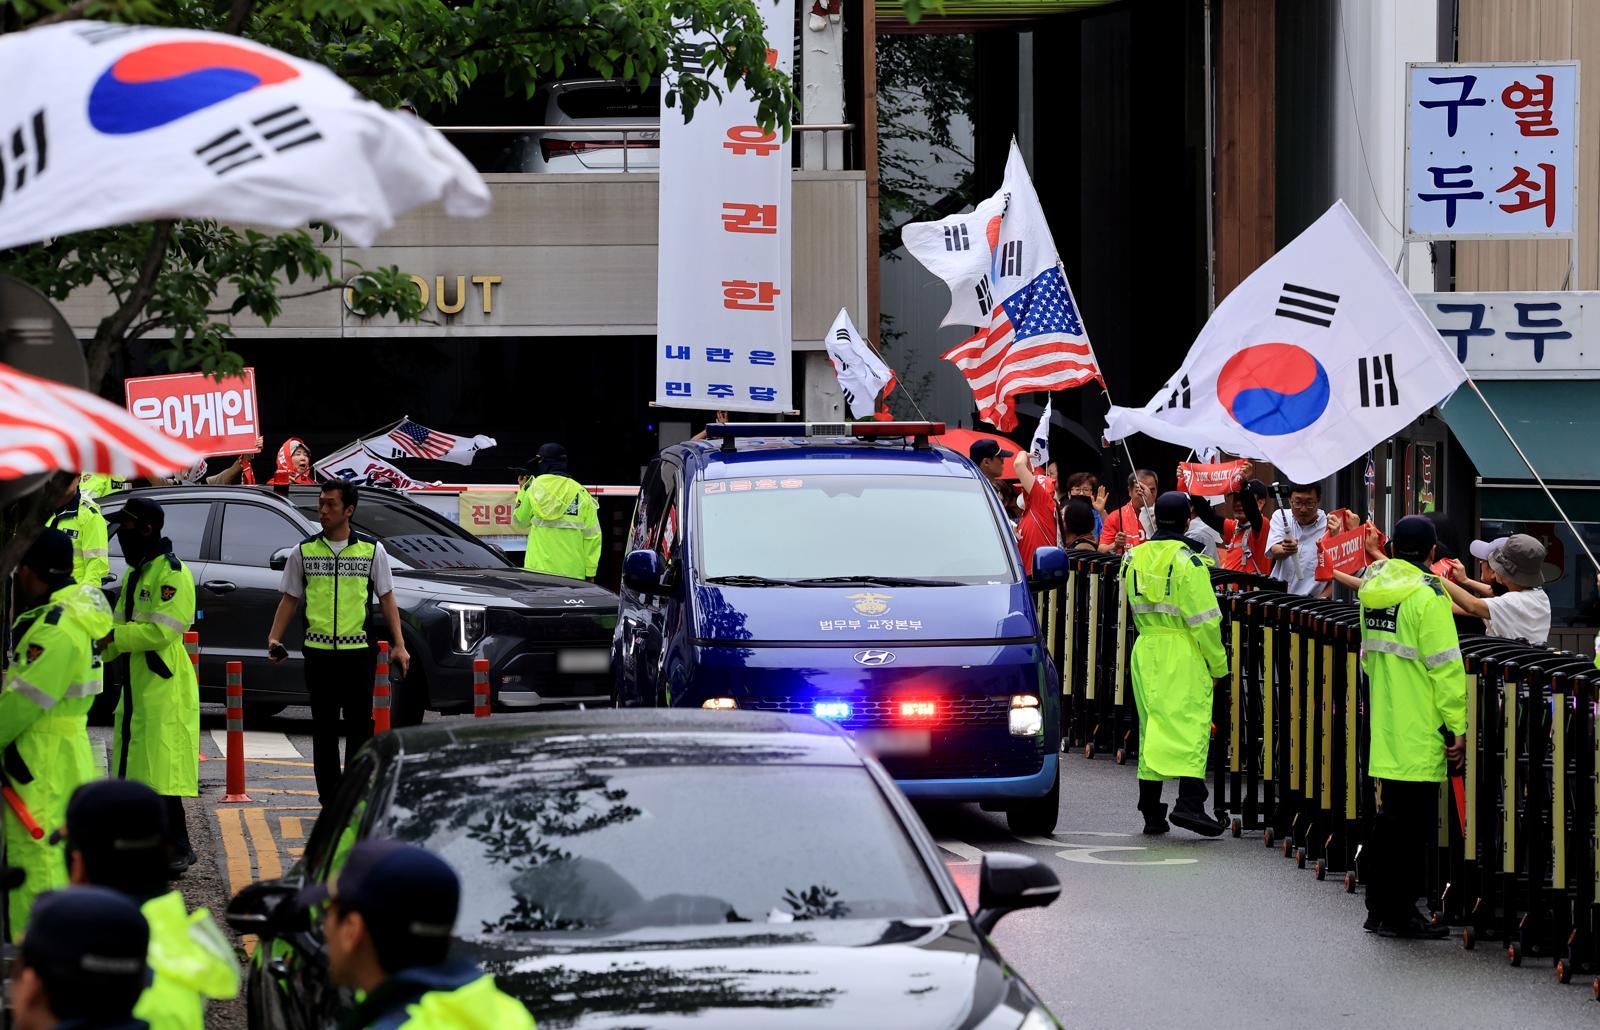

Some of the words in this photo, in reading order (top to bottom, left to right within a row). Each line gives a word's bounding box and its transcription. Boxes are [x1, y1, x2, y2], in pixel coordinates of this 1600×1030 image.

[1418, 74, 1487, 228] 구두
[1495, 74, 1560, 228] 열쇠
[1436, 302, 1573, 364] 구두
[665, 344, 776, 366] 내란은
[665, 381, 777, 402] 민주당
[471, 504, 512, 526] 진입
[305, 562, 320, 571] 대화
[321, 562, 335, 571] 경찰
[338, 562, 368, 572] POLICE
[820, 620, 862, 631] 법무부
[867, 619, 923, 631] 교정본부
[1365, 618, 1396, 630] POLCE
